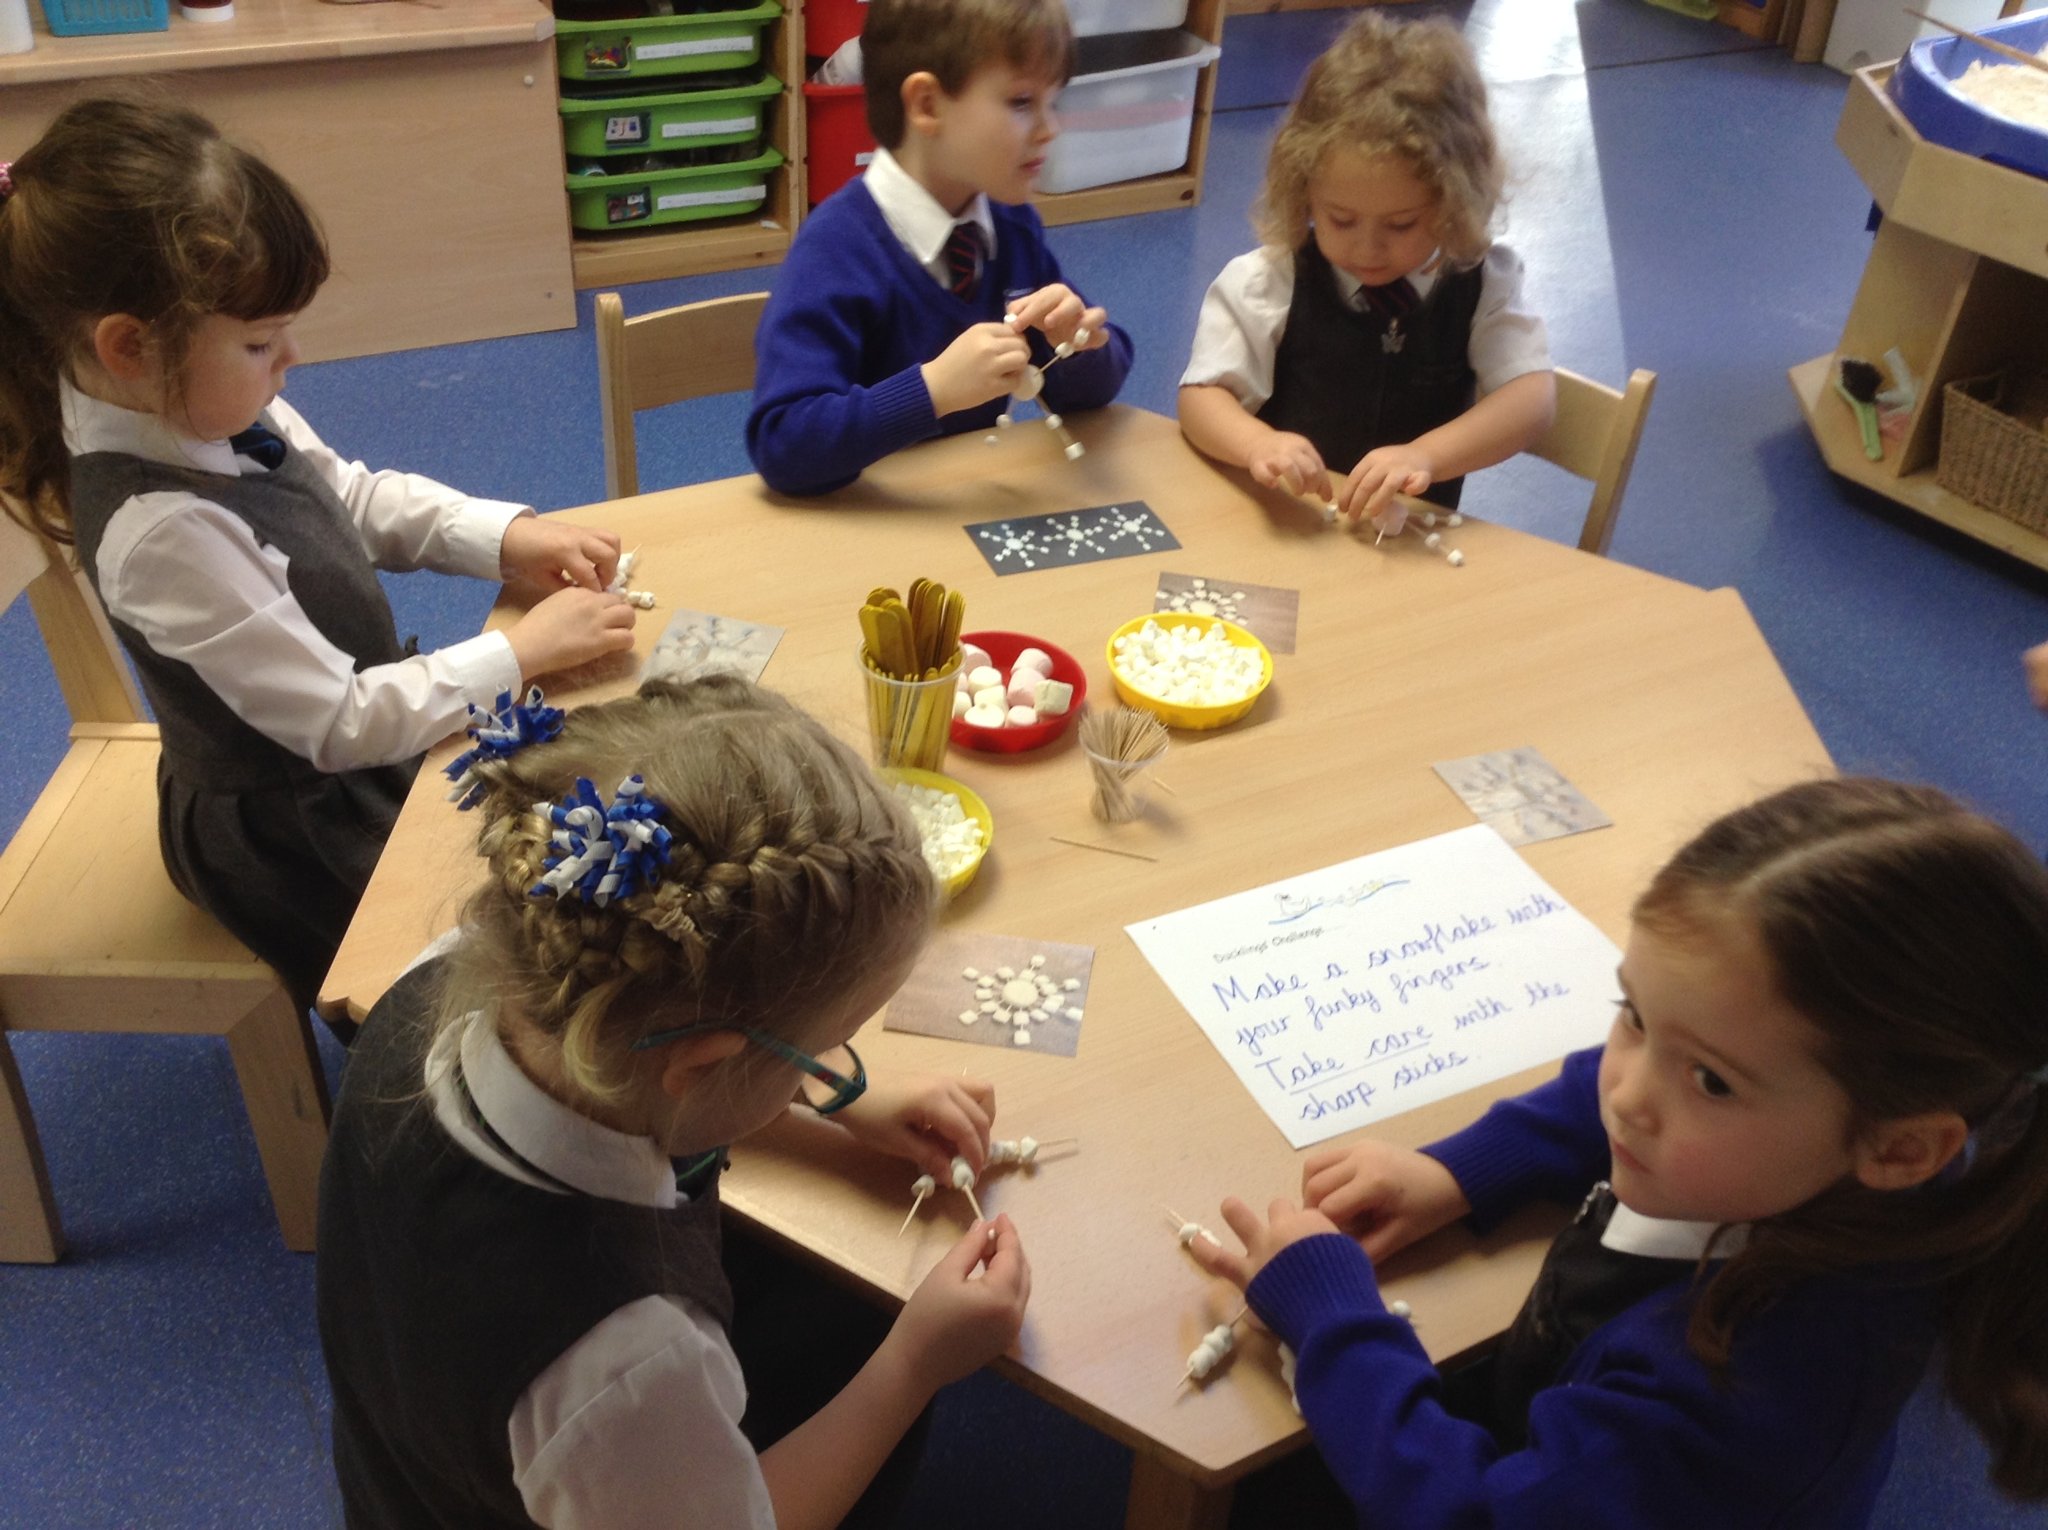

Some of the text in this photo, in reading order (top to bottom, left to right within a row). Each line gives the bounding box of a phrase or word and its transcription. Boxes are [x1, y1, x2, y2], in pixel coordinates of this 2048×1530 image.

[1211, 893, 1566, 1012] Make a snowflake with
[1236, 1015, 1290, 1057] your
[1305, 987, 1382, 1031] funky
[1255, 981, 1570, 1091] Take care with the
[1300, 1080, 1376, 1121] sharp
